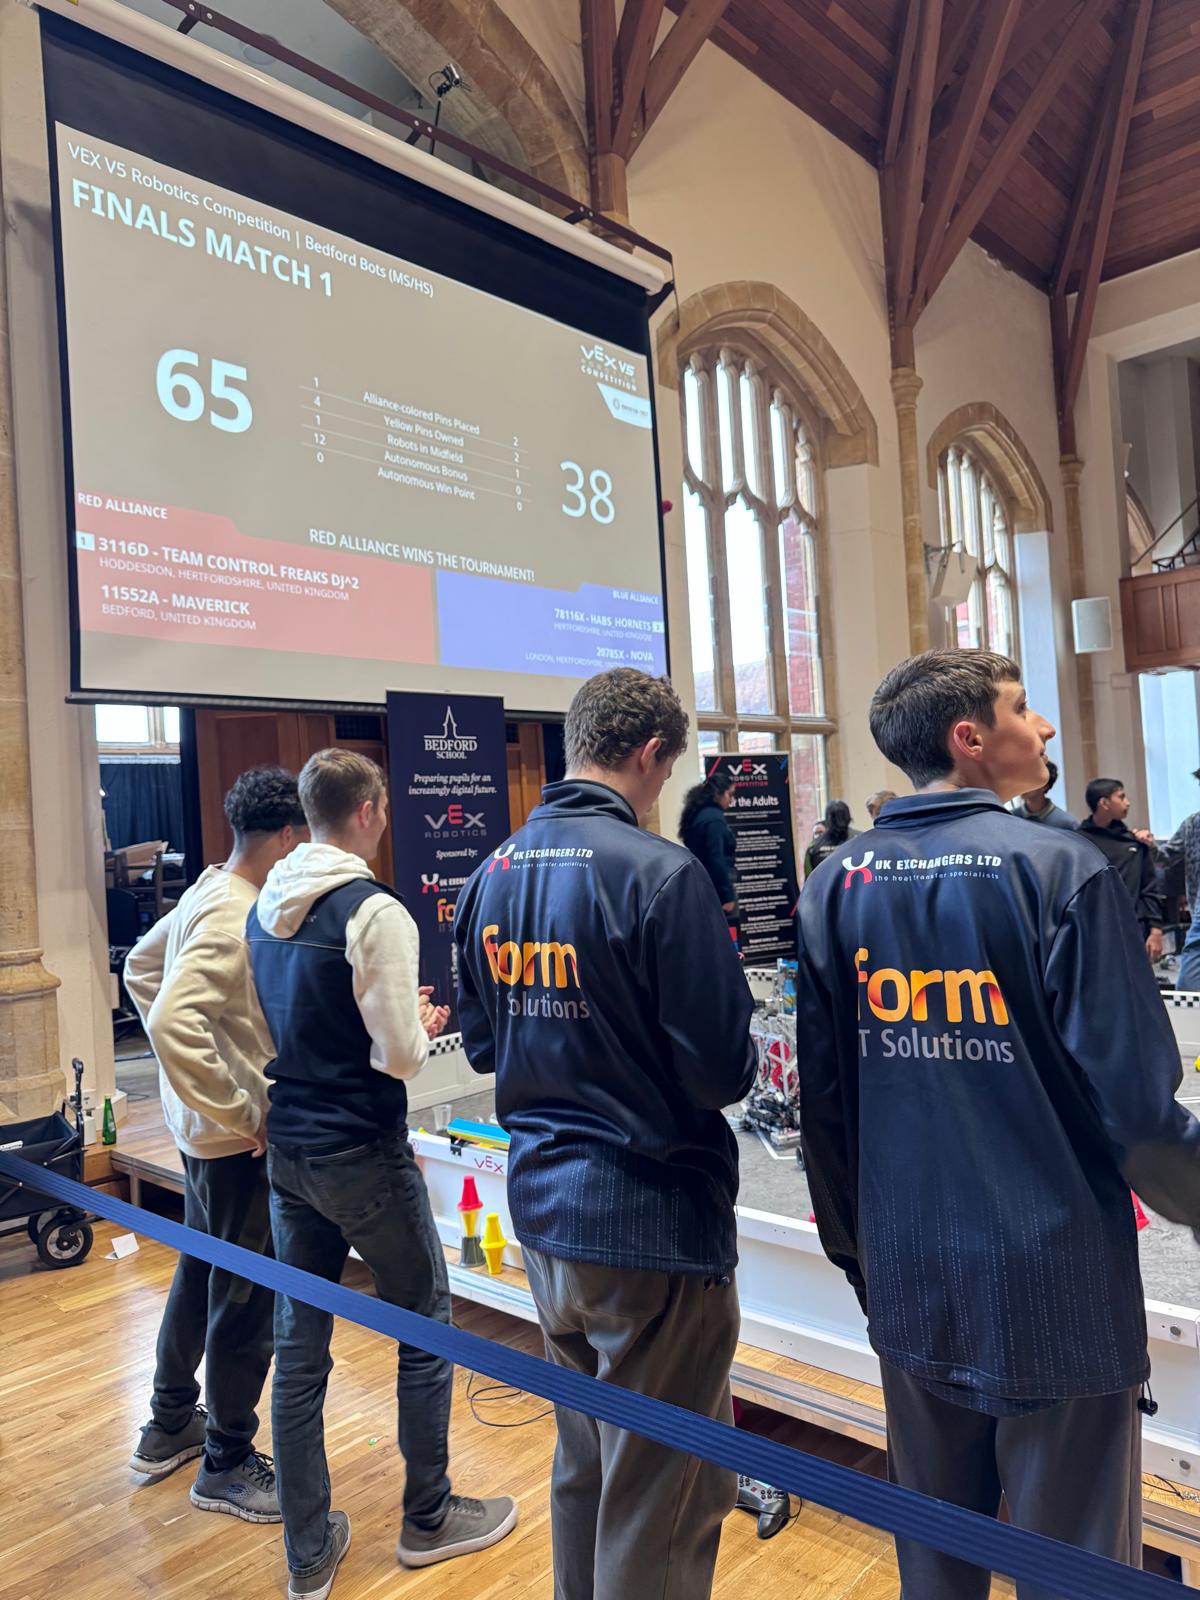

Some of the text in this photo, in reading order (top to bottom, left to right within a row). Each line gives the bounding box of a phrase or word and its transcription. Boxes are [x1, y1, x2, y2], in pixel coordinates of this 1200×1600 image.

[68, 142, 101, 170] VEX
[105, 156, 126, 178] V5
[132, 167, 199, 205] Robotics
[203, 196, 291, 242] Competition
[305, 234, 356, 267] Bedford
[360, 257, 387, 278] Bots
[389, 268, 434, 298] (MS/HS)
[72, 178, 332, 297] FINALS MATCH 1
[580, 345, 617, 370] VEX
[313, 377, 319, 387] 1
[156, 348, 253, 433] 65
[313, 396, 321, 407] 4
[315, 415, 321, 426] 1
[363, 391, 480, 435] Alliance-colored Pins Placed
[314, 432, 326, 446] 12
[384, 415, 464, 447] Yellow Pins Owned
[387, 434, 464, 464] Robots in Midfield
[513, 436, 519, 447] 2
[317, 452, 324, 463] 0
[514, 453, 520, 463] 2
[384, 451, 468, 482] Autonomous Bonus
[515, 469, 520, 479] 1
[377, 467, 476, 500] Autonomous Win Point
[516, 485, 522, 495] 0
[560, 460, 615, 525] 38
[78, 492, 168, 520] RED ALLIANCE
[517, 501, 523, 511] 0
[98, 536, 149, 557] 3116D
[161, 546, 204, 567] TEAM
[207, 554, 277, 577] CONTROL
[280, 566, 329, 585] FREAKS
[309, 528, 536, 582] RED ALLIANCE WINS THE TOURNAMENT!
[99, 557, 350, 601] HODDESDON, HERTFORDSHIRE, UNITED KINGDOM
[101, 584, 160, 605] 11552A
[172, 593, 250, 615] MAVERICK
[612, 590, 659, 605] BLUE ALLIANCE
[102, 603, 256, 630] BEDFORD, UNITED KINGDOM
[630, 650, 654, 662] NOVA
[424, 739, 478, 751] BEDFORD
[436, 751, 467, 760] SCHOOL
[727, 759, 768, 776] VEX
[414, 773, 449, 785] Preparing
[449, 773, 470, 785] pupils
[470, 773, 481, 784] for
[408, 785, 451, 797] increasingly
[451, 785, 474, 797] digital
[738, 796, 752, 808] the
[752, 794, 780, 807] Adults
[424, 804, 486, 830] VEX
[424, 829, 487, 839] ROBOTICS
[435, 850, 468, 861] Sponsored
[513, 848, 594, 861] UK EXCHANGERS LTD
[875, 854, 1002, 870] UK EXCHANGERS LTD
[949, 870, 999, 880] specialists
[437, 898, 456, 923] fo
[482, 924, 581, 989] form
[881, 1027, 1015, 1064] Solutions
[474, 1155, 504, 1174] VEX
